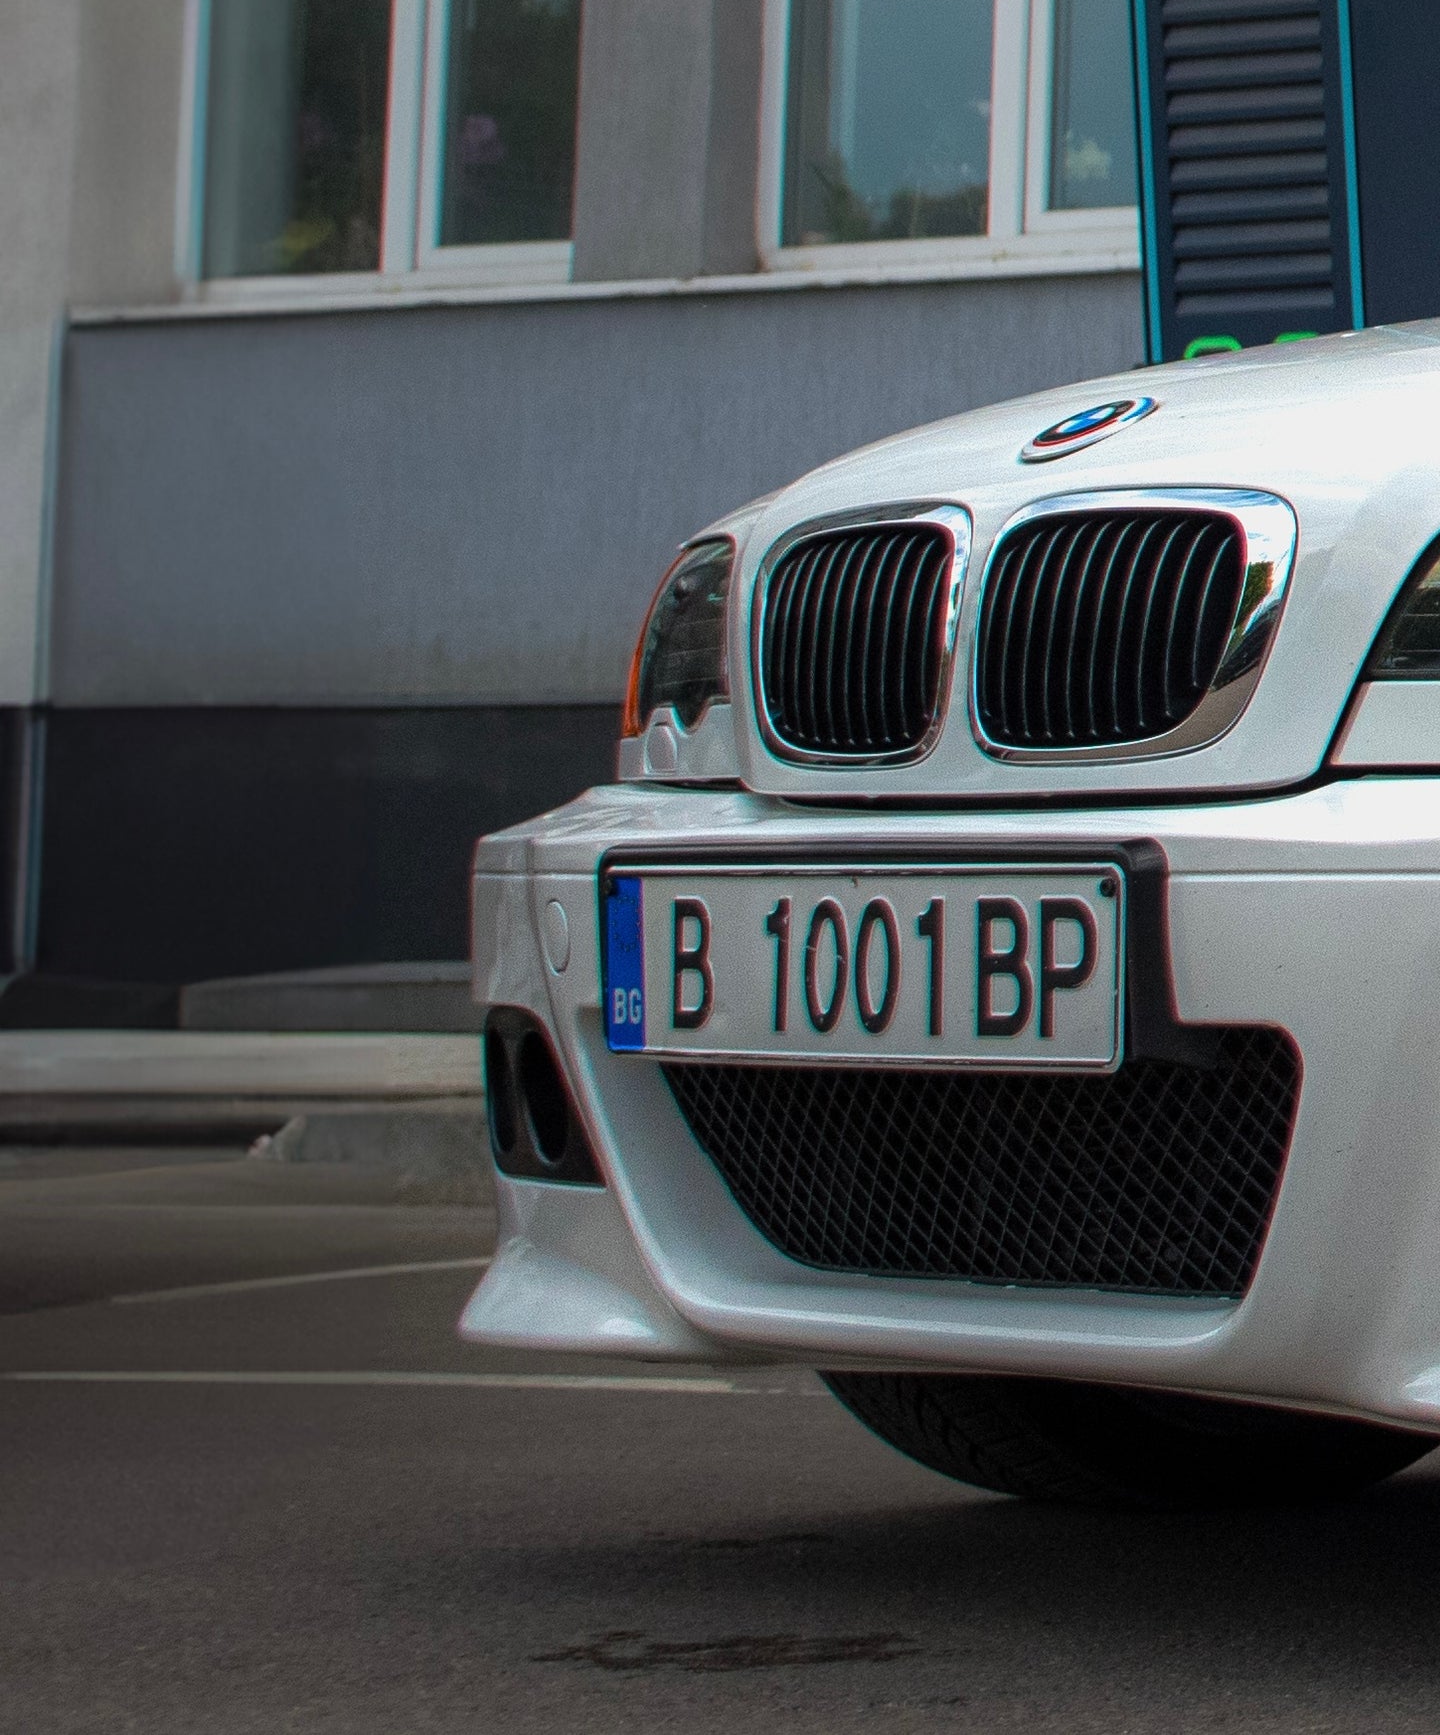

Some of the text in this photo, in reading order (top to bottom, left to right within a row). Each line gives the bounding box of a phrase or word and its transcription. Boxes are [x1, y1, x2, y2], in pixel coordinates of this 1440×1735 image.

[613, 987, 642, 1025] BG
[672, 895, 1099, 1039] B 1001 BP
